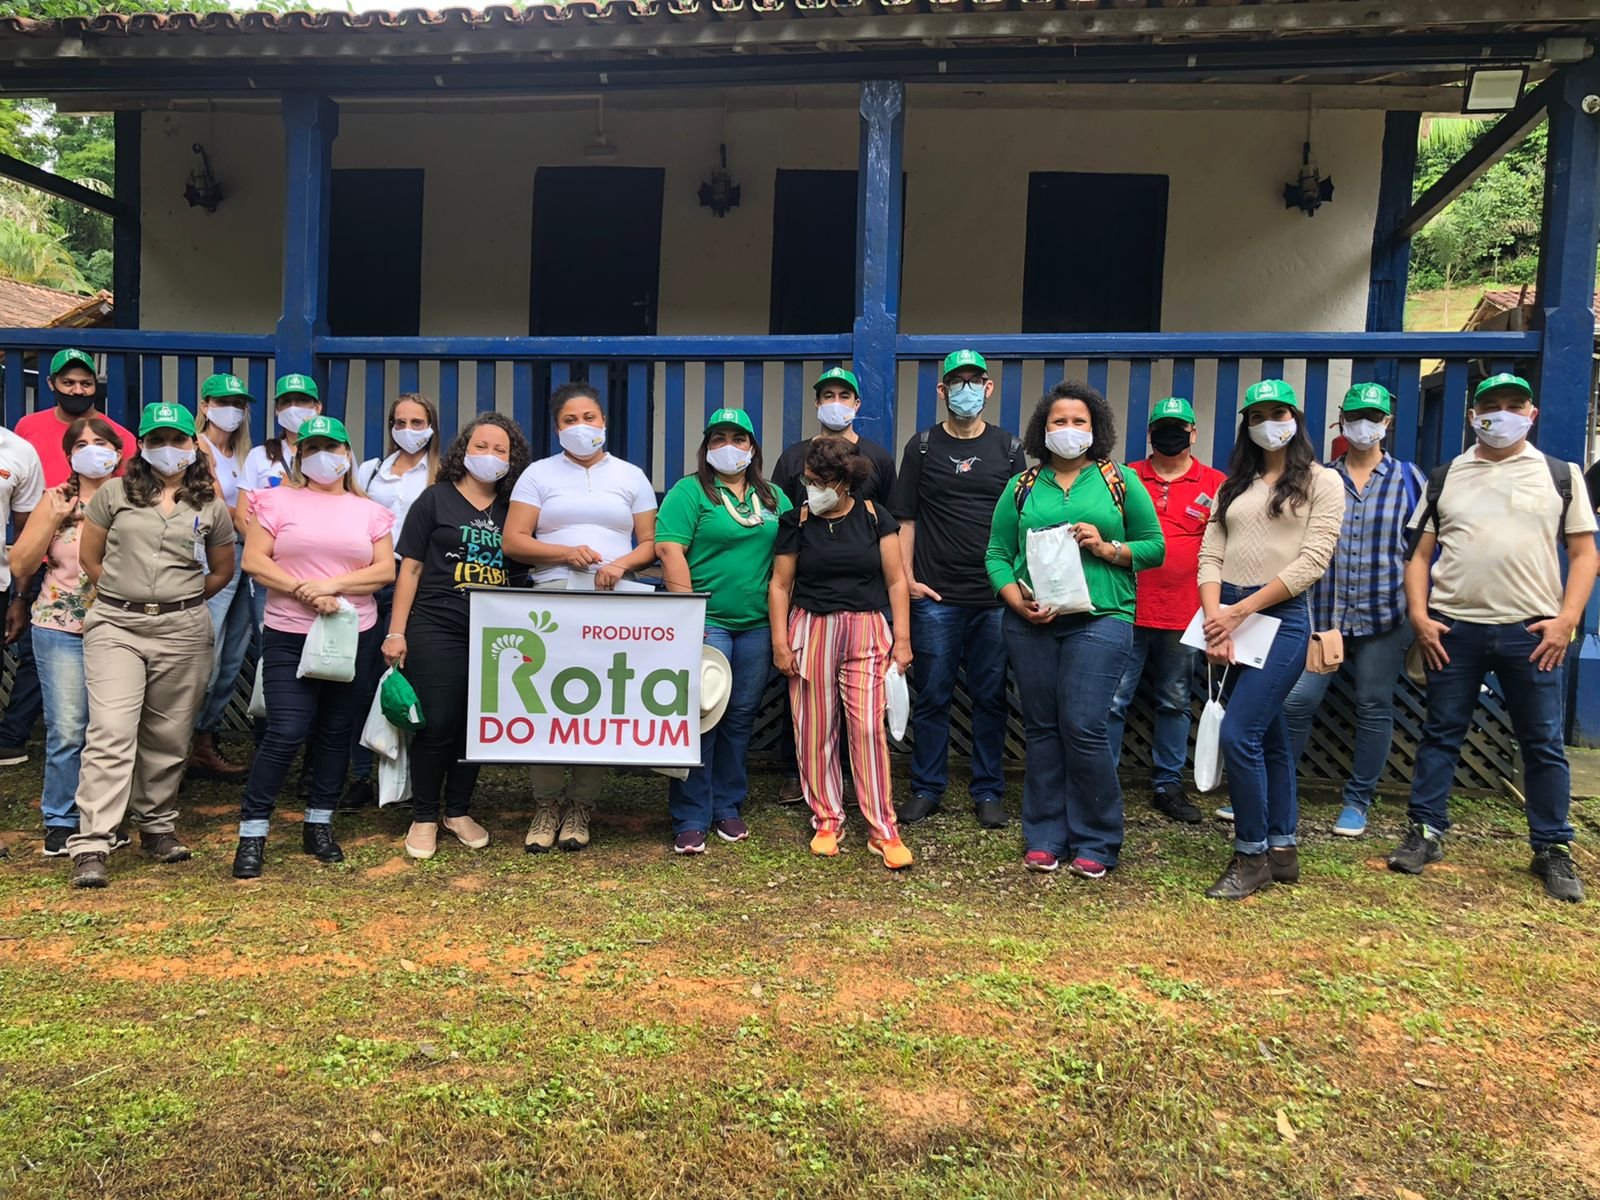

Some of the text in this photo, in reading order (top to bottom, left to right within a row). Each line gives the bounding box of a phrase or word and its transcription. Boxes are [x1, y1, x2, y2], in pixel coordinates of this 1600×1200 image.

[460, 525, 503, 547] TERR
[466, 543, 503, 568] BOA
[582, 625, 675, 641] PRODUTOS
[480, 627, 689, 716] Rota
[479, 716, 690, 747] DO MUTUM
